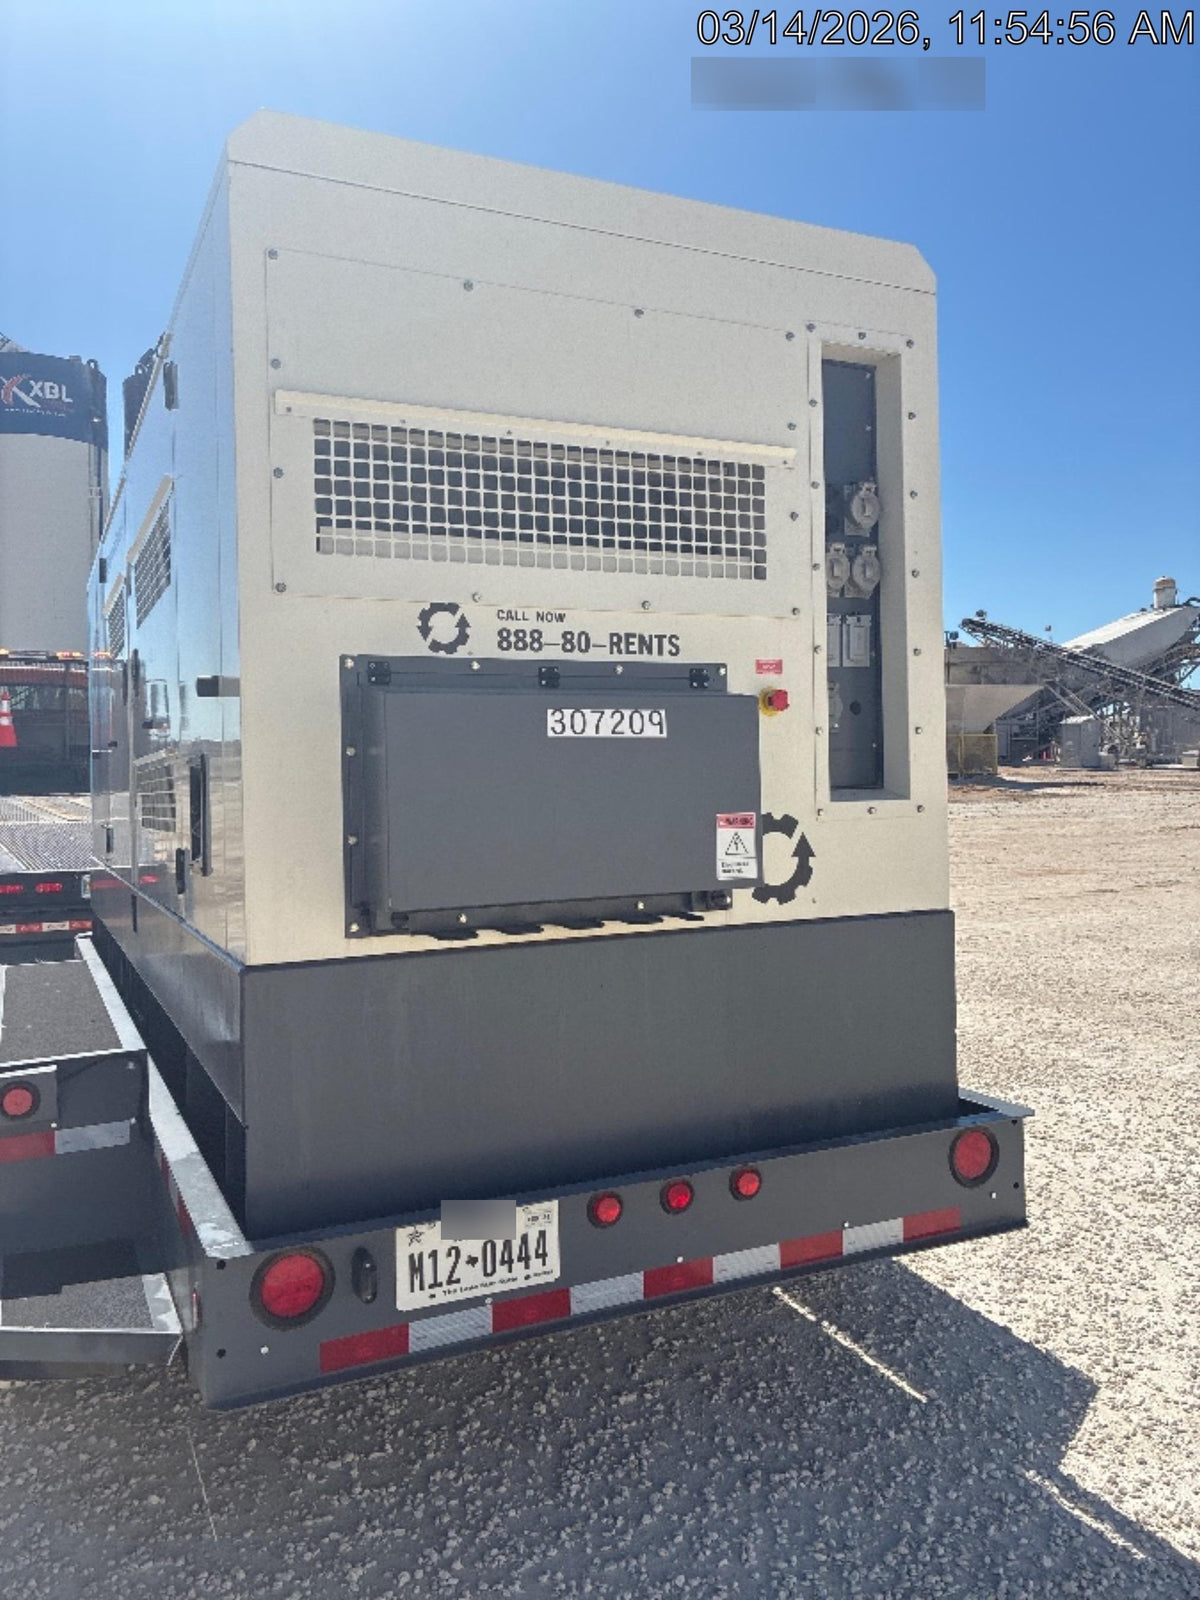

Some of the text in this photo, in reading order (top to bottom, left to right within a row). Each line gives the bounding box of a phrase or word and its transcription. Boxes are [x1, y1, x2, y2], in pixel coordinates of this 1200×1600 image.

[29, 380, 73, 403] XBL
[497, 609, 566, 623] CALL NOW
[551, 709, 664, 735] 307209
